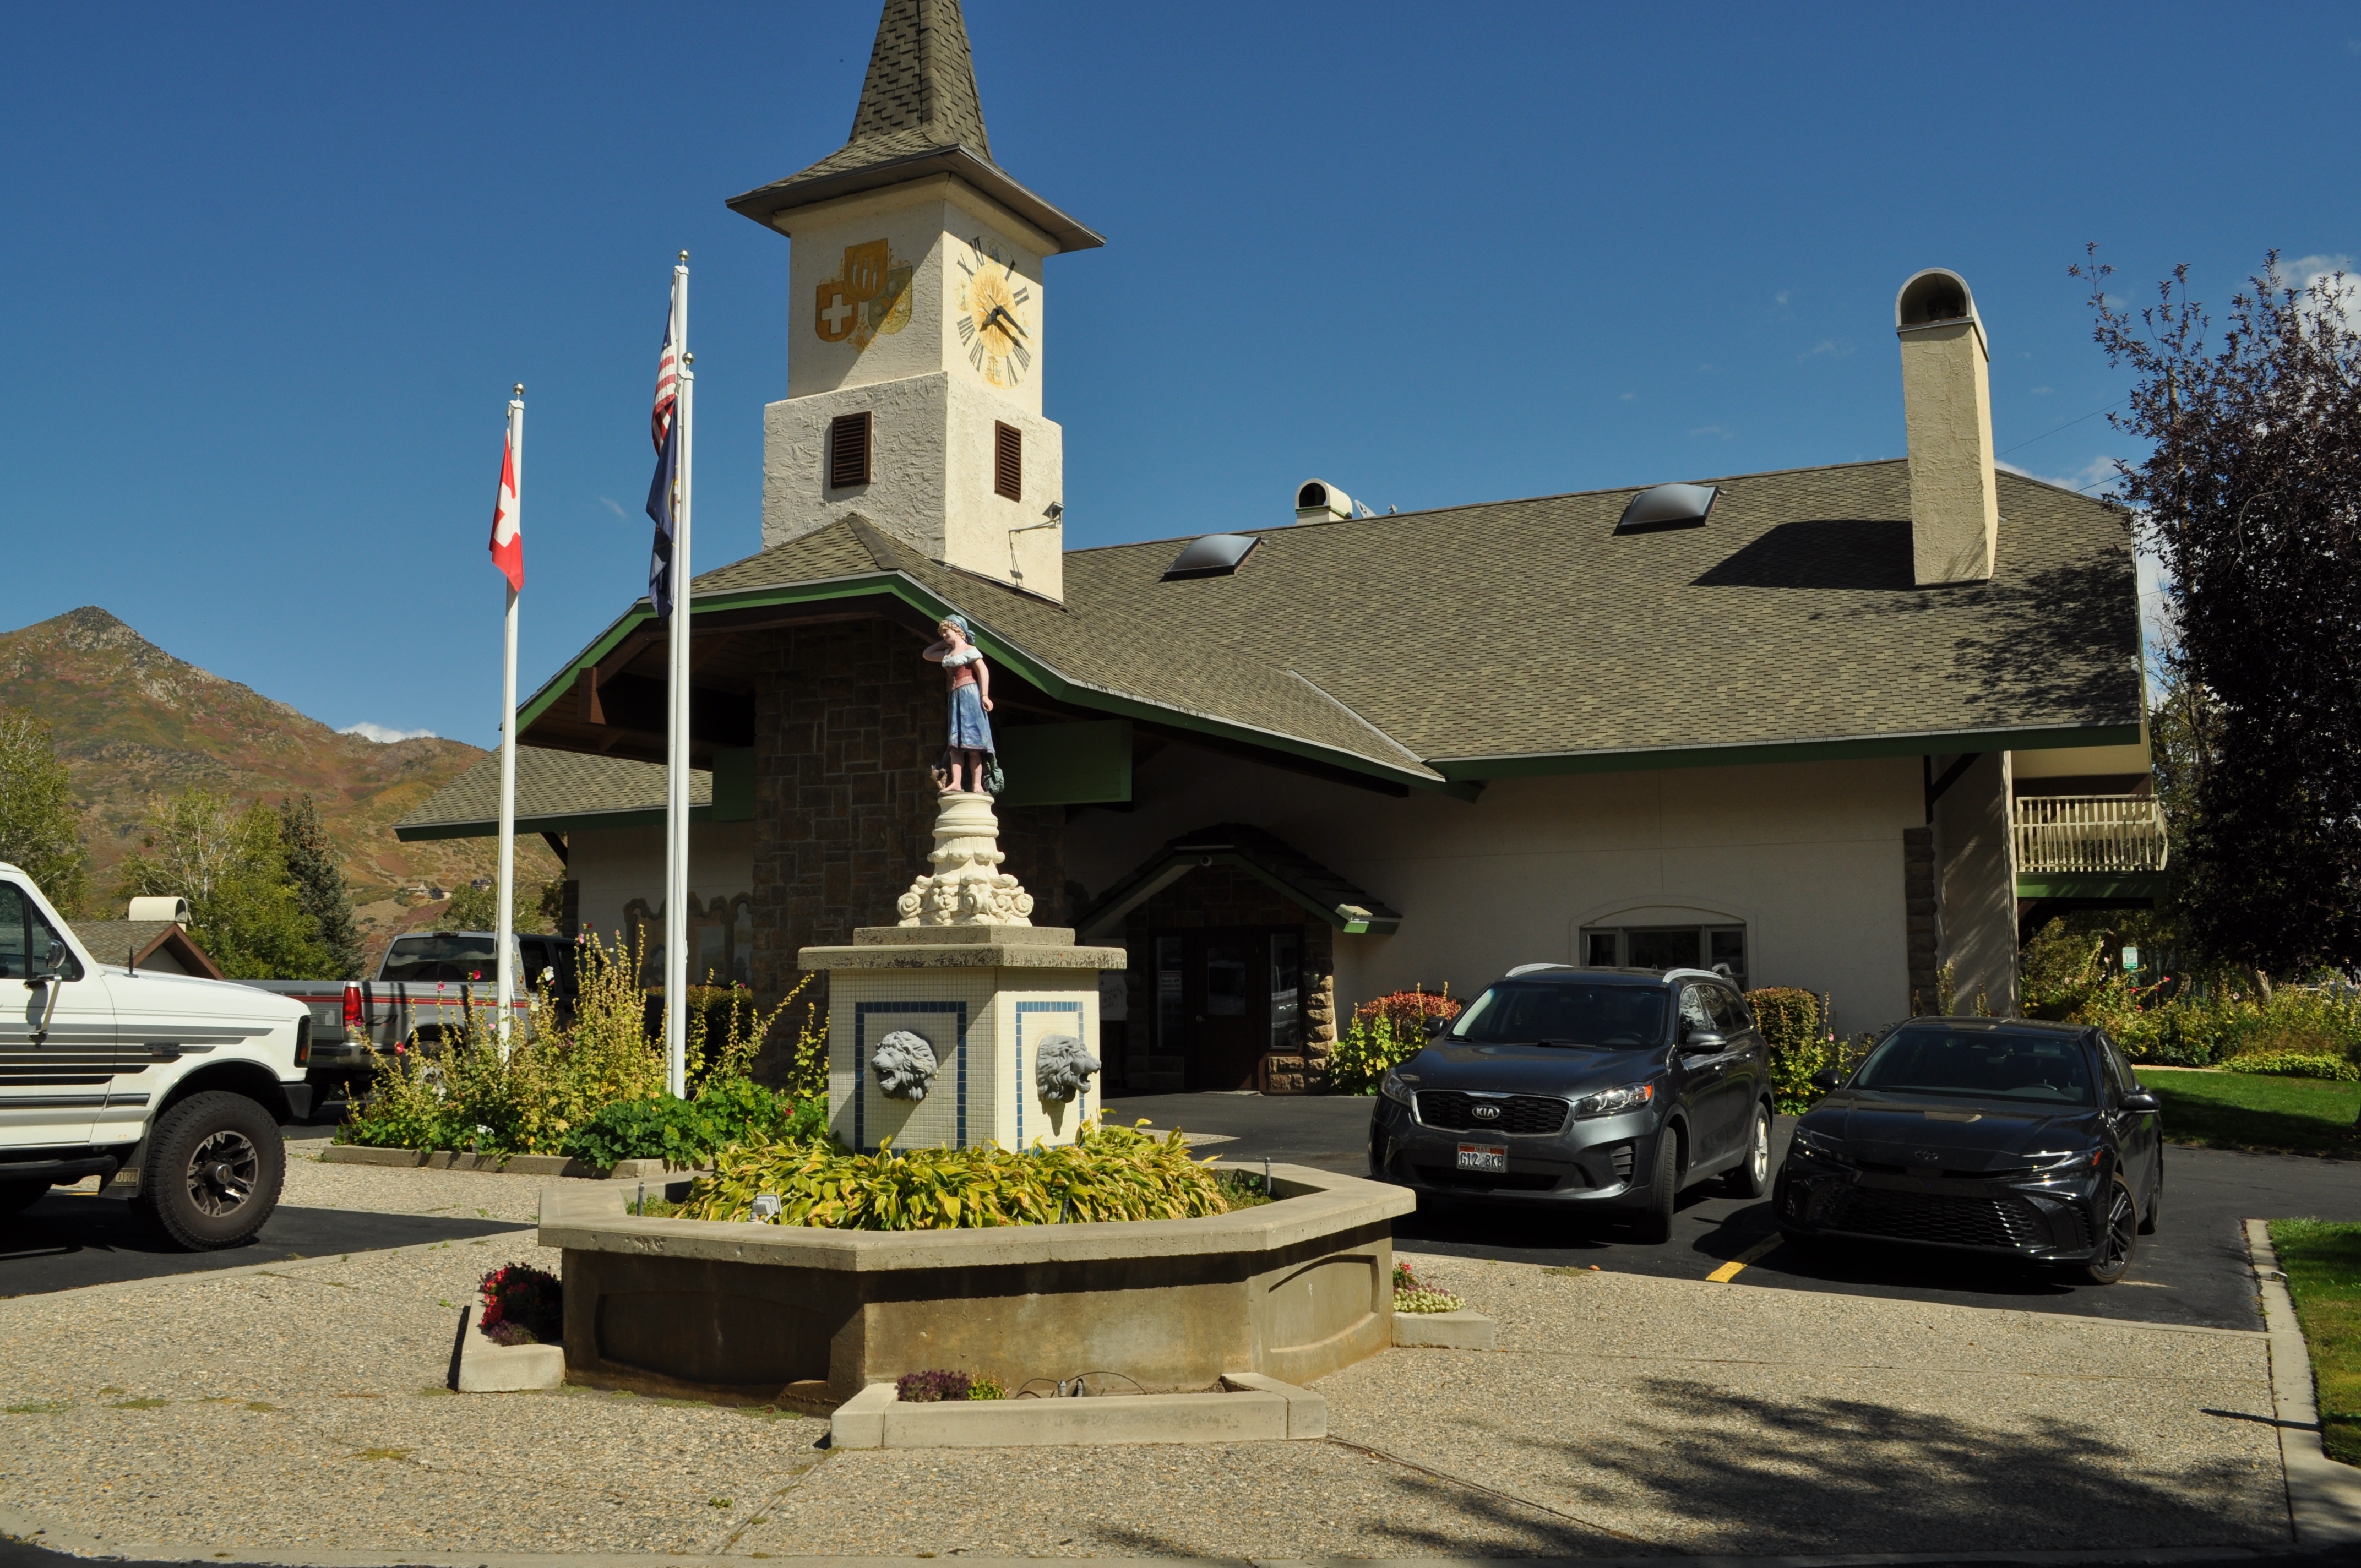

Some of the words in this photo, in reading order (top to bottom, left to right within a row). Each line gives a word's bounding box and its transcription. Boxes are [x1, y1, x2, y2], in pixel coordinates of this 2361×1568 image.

[367, 1015, 398, 1026] Z71
[1476, 1108, 1494, 1117] KIA
[115, 1172, 138, 1182] ORD
